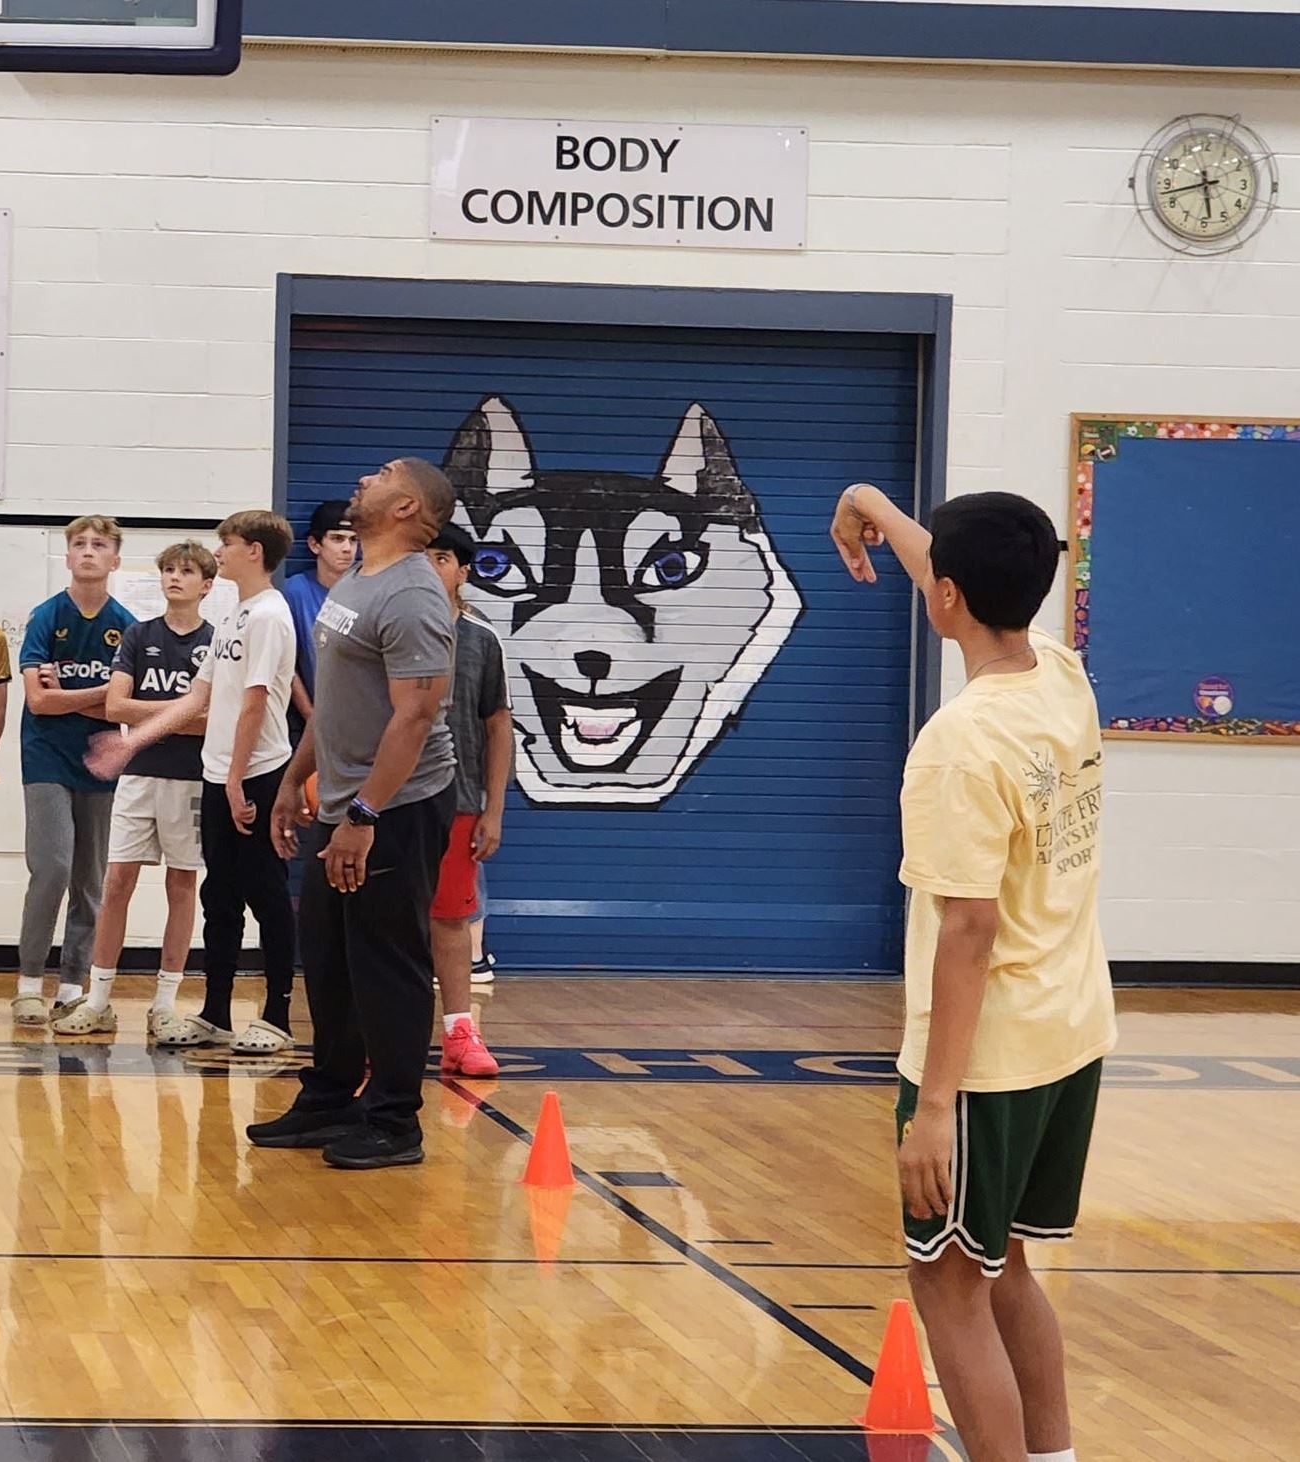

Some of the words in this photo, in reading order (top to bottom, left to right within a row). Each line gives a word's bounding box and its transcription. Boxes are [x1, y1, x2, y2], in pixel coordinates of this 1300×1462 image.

[555, 135, 681, 173] BODY
[1163, 178, 1171, 190] 9
[1240, 179, 1248, 190] 3
[1169, 197, 1177, 208] 8
[1234, 198, 1243, 209] 4
[461, 188, 774, 232] COMPOSITION
[1182, 210, 1189, 222] 7
[1200, 216, 1208, 228] 6
[1220, 211, 1229, 222] 5
[139, 667, 192, 694] AVS
